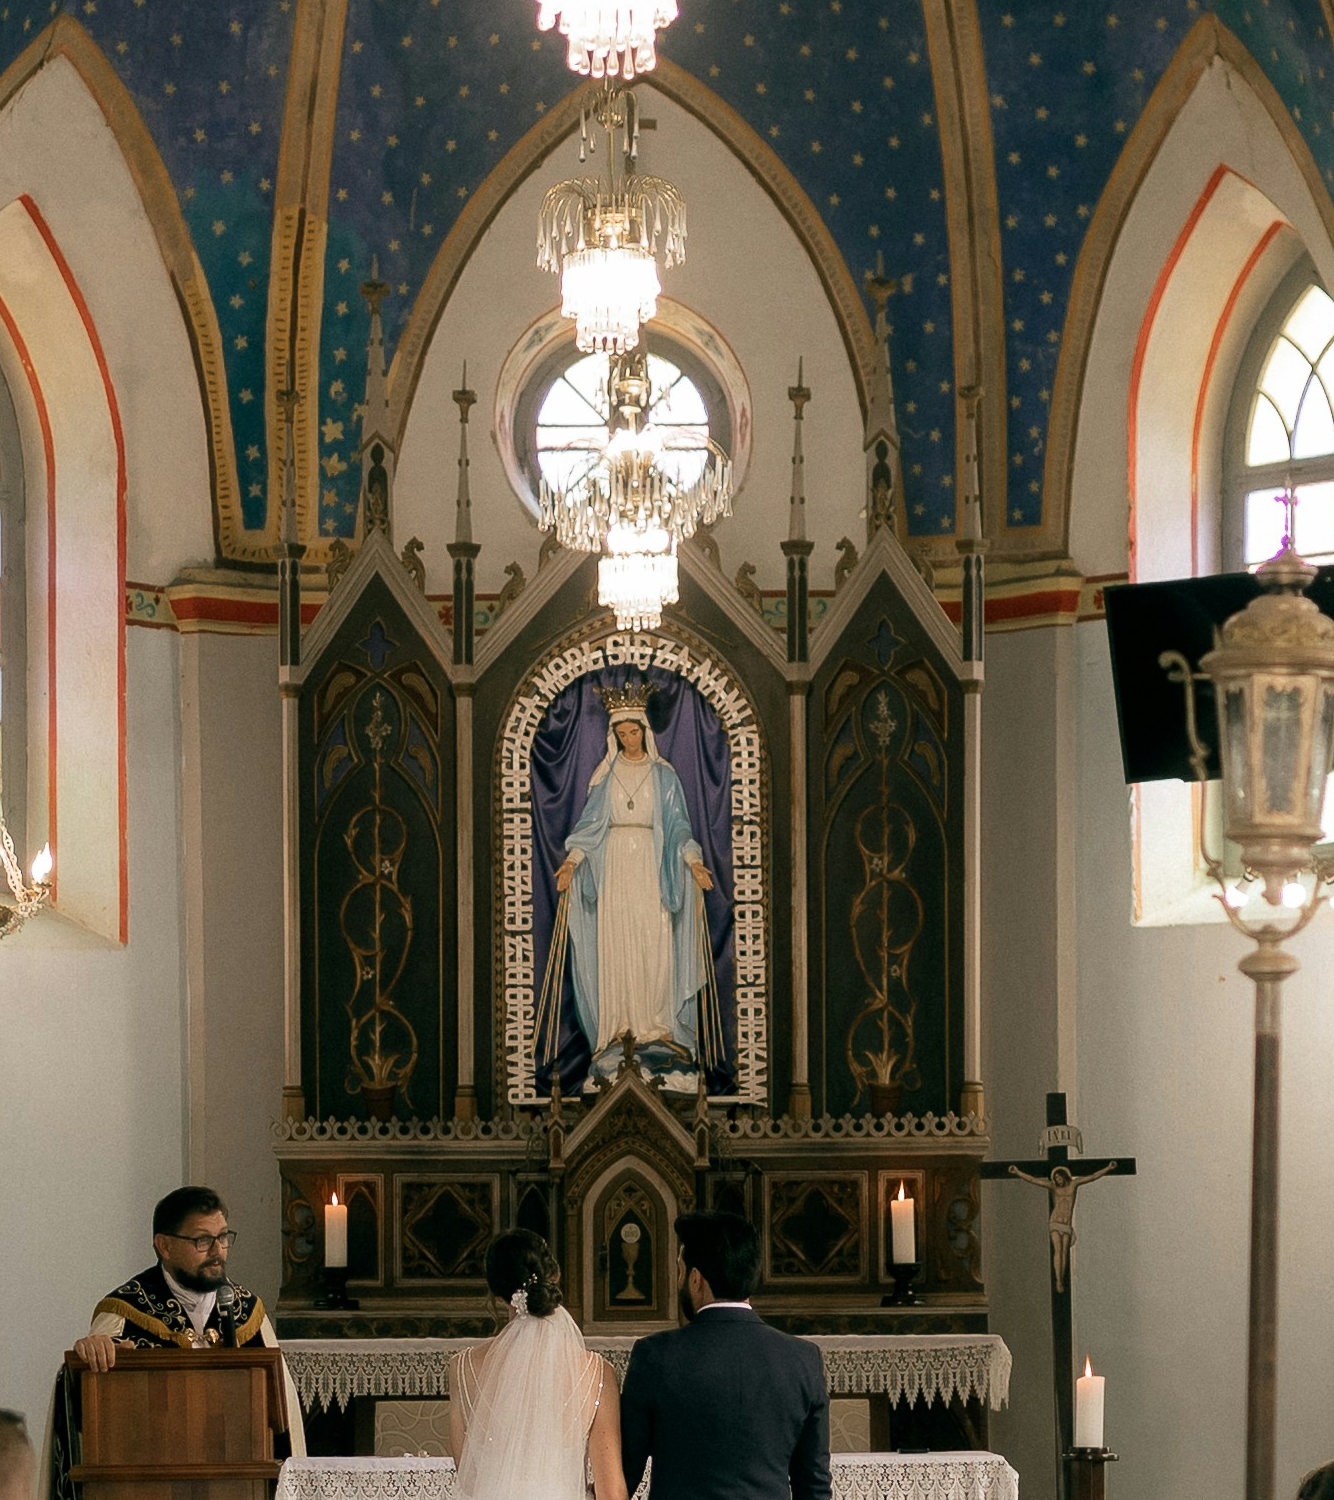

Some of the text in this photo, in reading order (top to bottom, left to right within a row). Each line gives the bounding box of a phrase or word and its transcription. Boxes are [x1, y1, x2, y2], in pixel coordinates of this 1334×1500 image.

[605, 634, 654, 671] SIĘ
[652, 638, 692, 677] ZA
[687, 658, 753, 728] NAMI
[502, 813, 534, 931] GRZECHU
[733, 868, 763, 901] DO
[734, 904, 766, 985] CIEBIE
[737, 987, 769, 1108] UCIEKAMY
